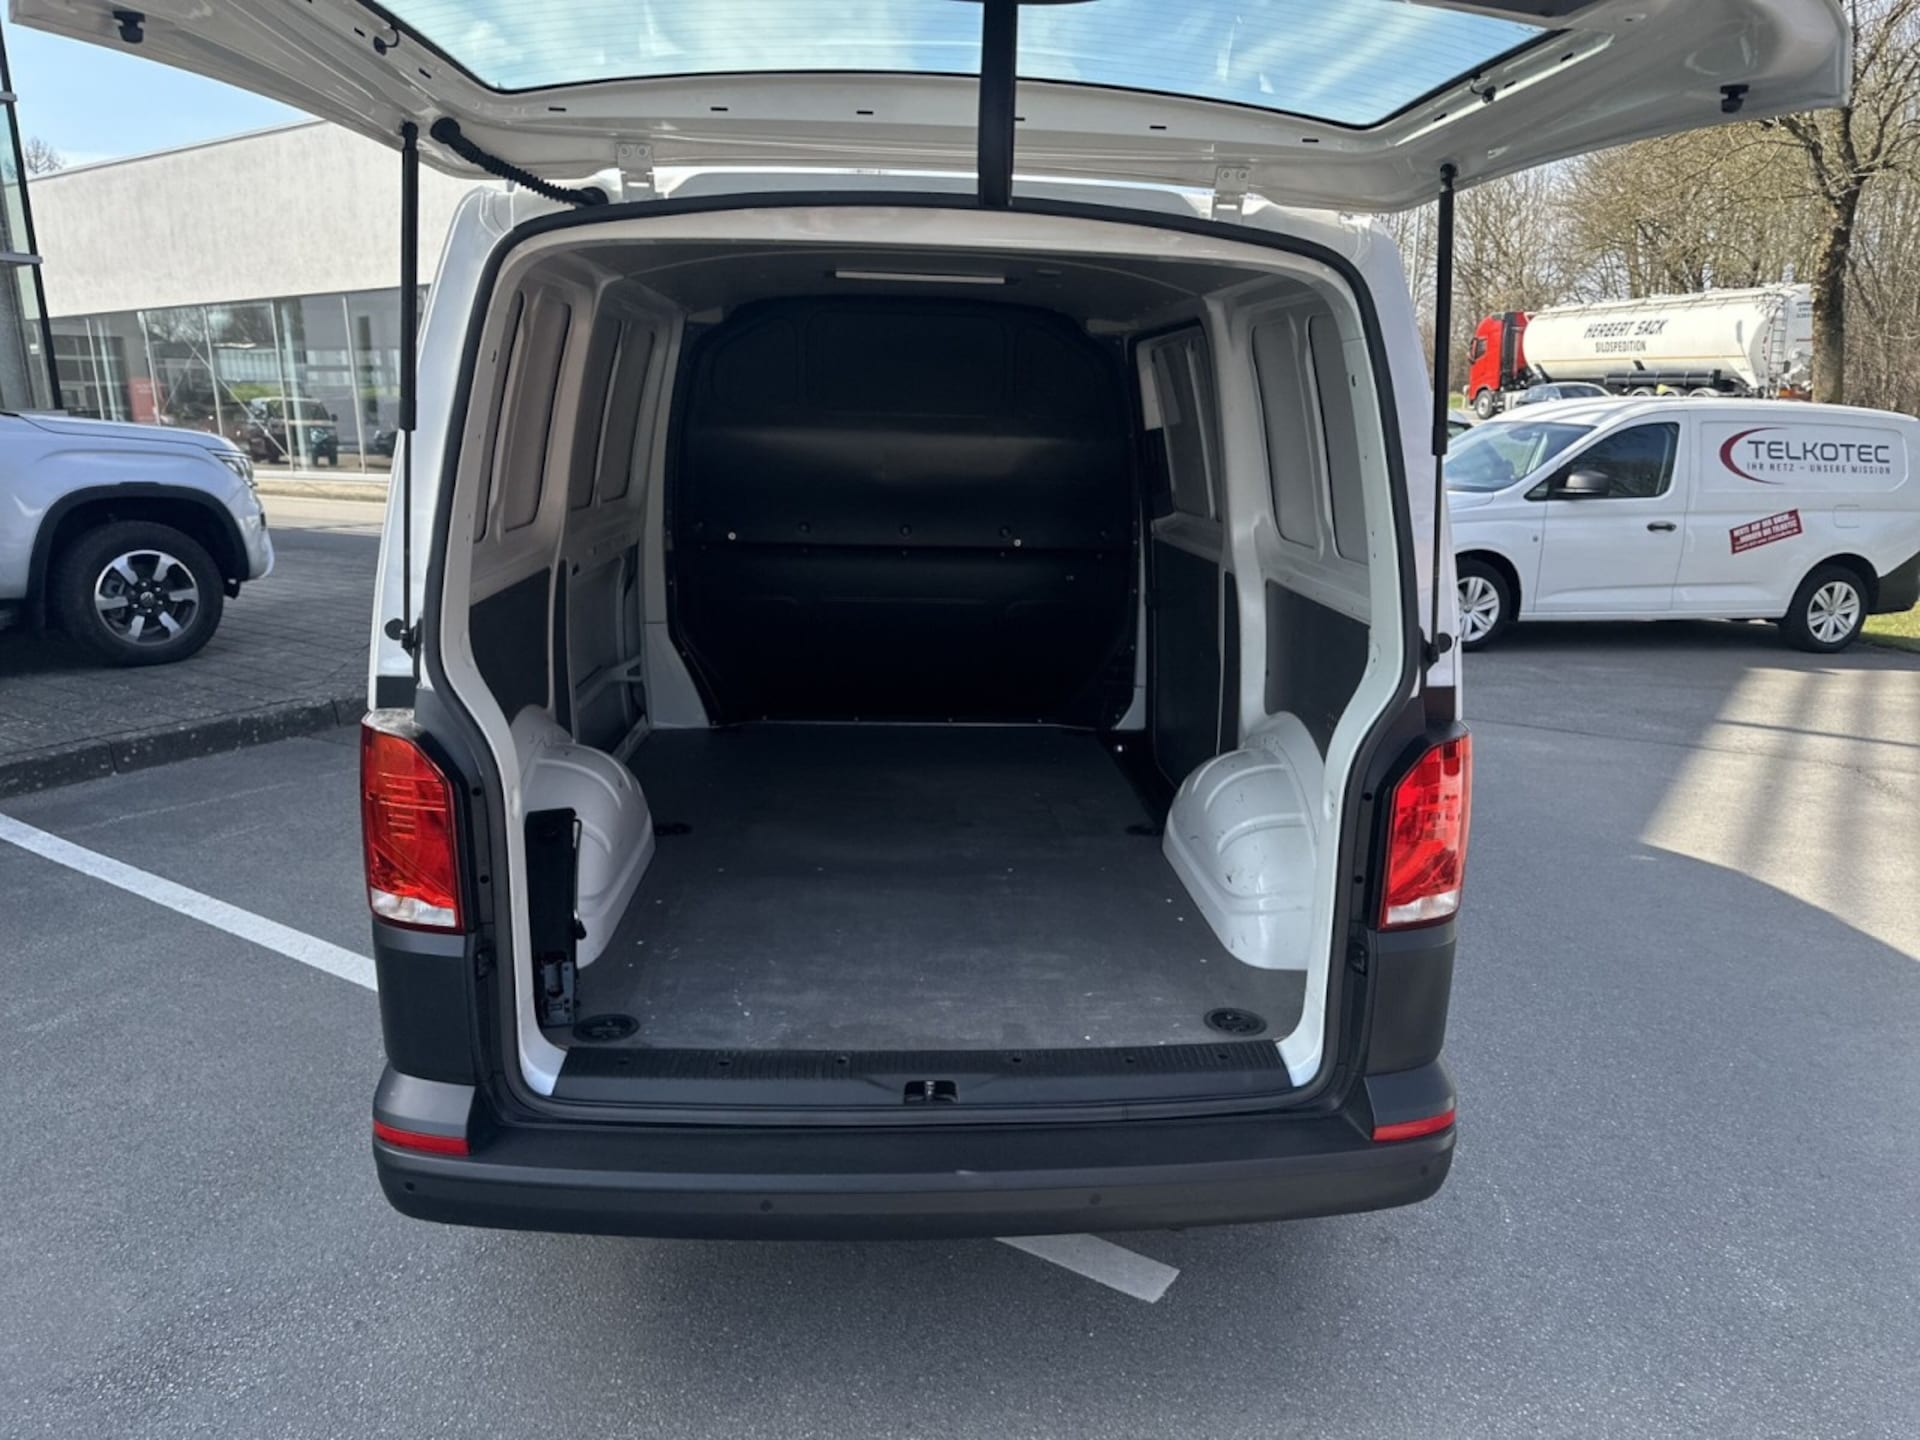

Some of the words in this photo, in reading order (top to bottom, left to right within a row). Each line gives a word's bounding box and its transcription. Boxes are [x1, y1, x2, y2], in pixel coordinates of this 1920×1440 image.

[1584, 321, 1635, 339] HERBERT
[1634, 319, 1669, 335] SACK
[1595, 340, 1647, 352] SILOSPEDITION
[1747, 440, 1890, 463] TELKOTEC
[1746, 462, 1764, 471] IHR
[1769, 463, 1795, 472] NETZ
[1810, 464, 1847, 473] UNSERE
[1851, 465, 1890, 475] MISSION
